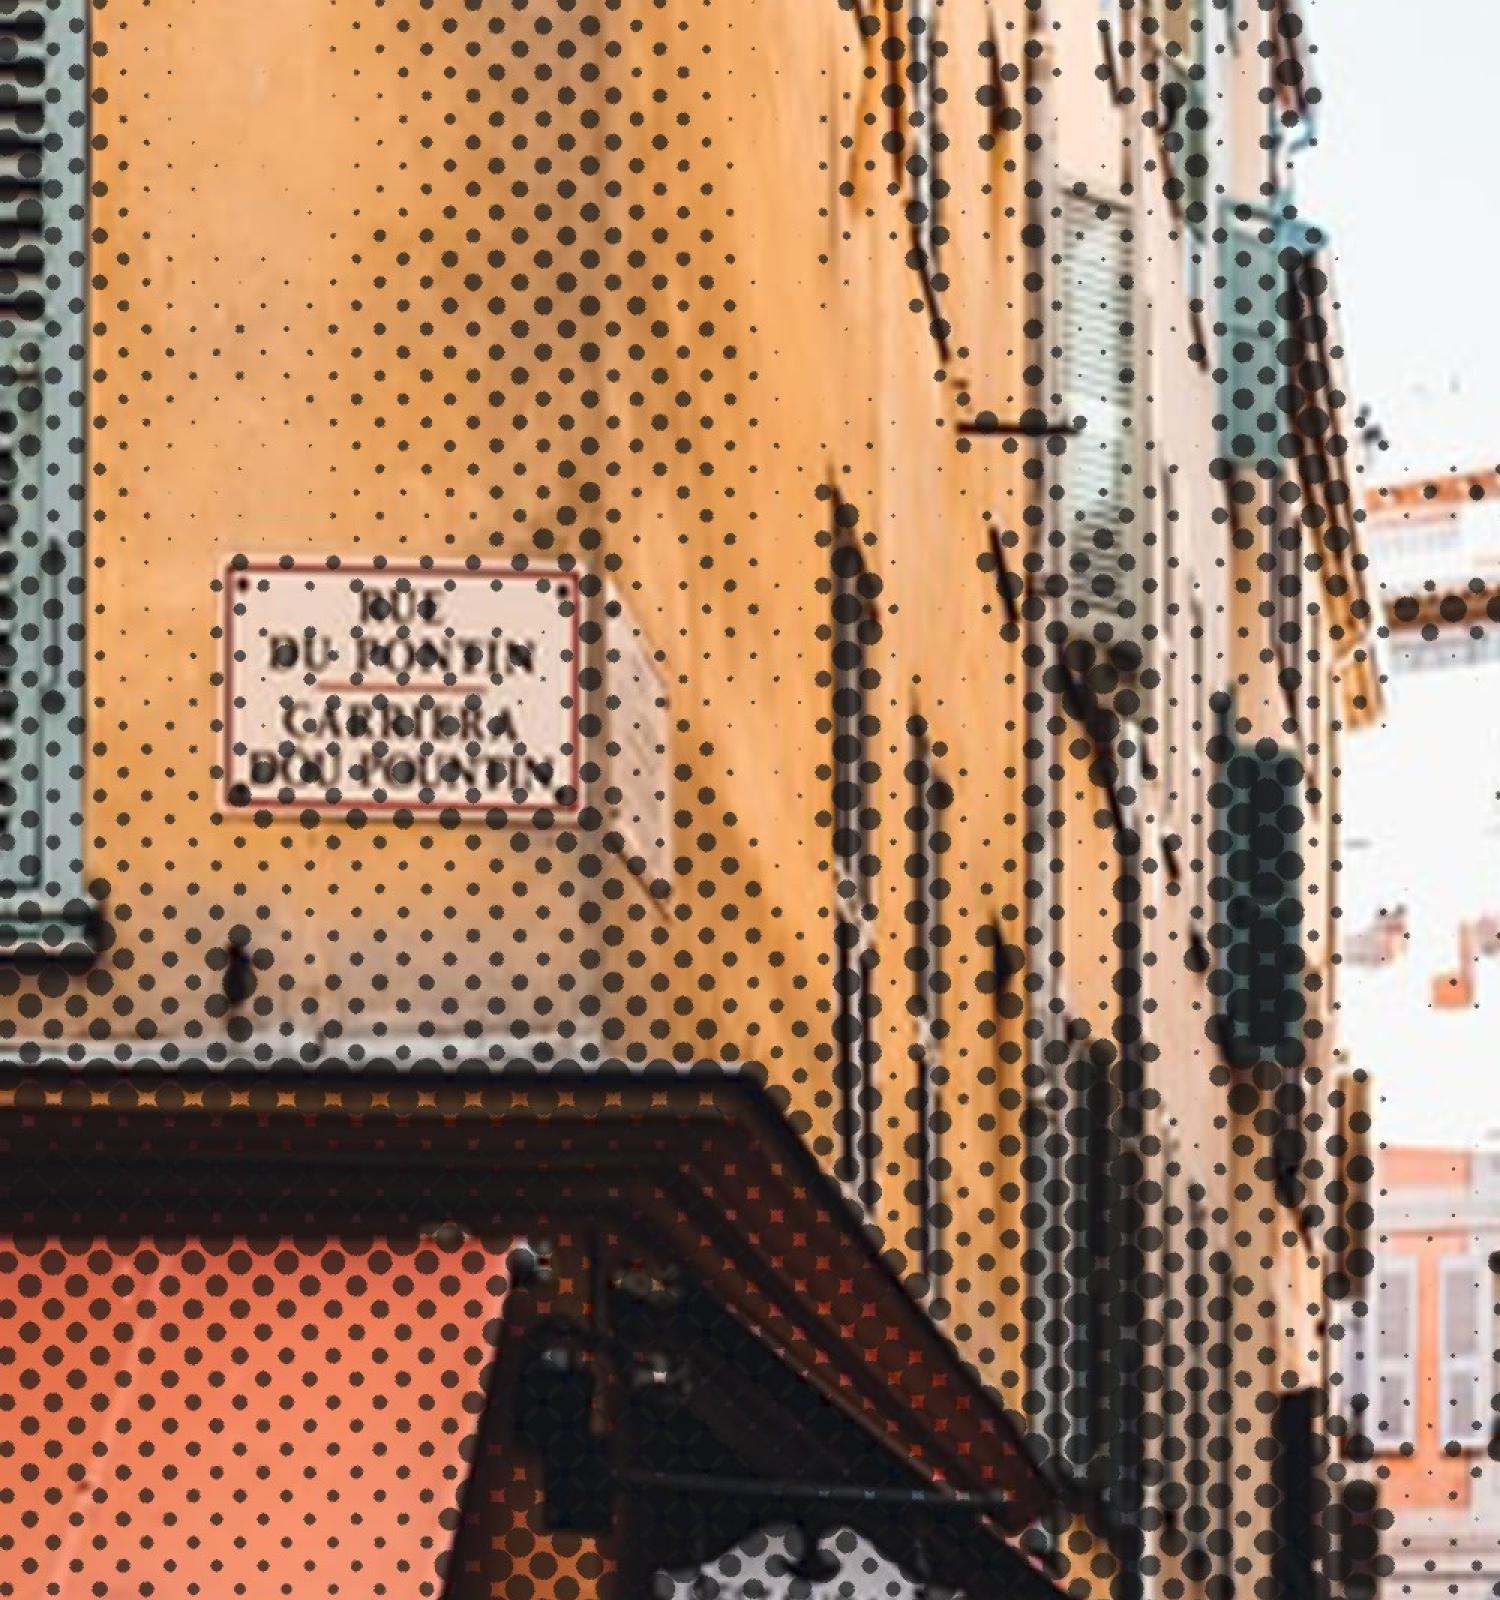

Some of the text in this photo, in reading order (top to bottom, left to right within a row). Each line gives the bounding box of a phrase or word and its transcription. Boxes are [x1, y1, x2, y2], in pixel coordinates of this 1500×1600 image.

[359, 588, 445, 625] RUE
[268, 635, 537, 676] DU PONTIN
